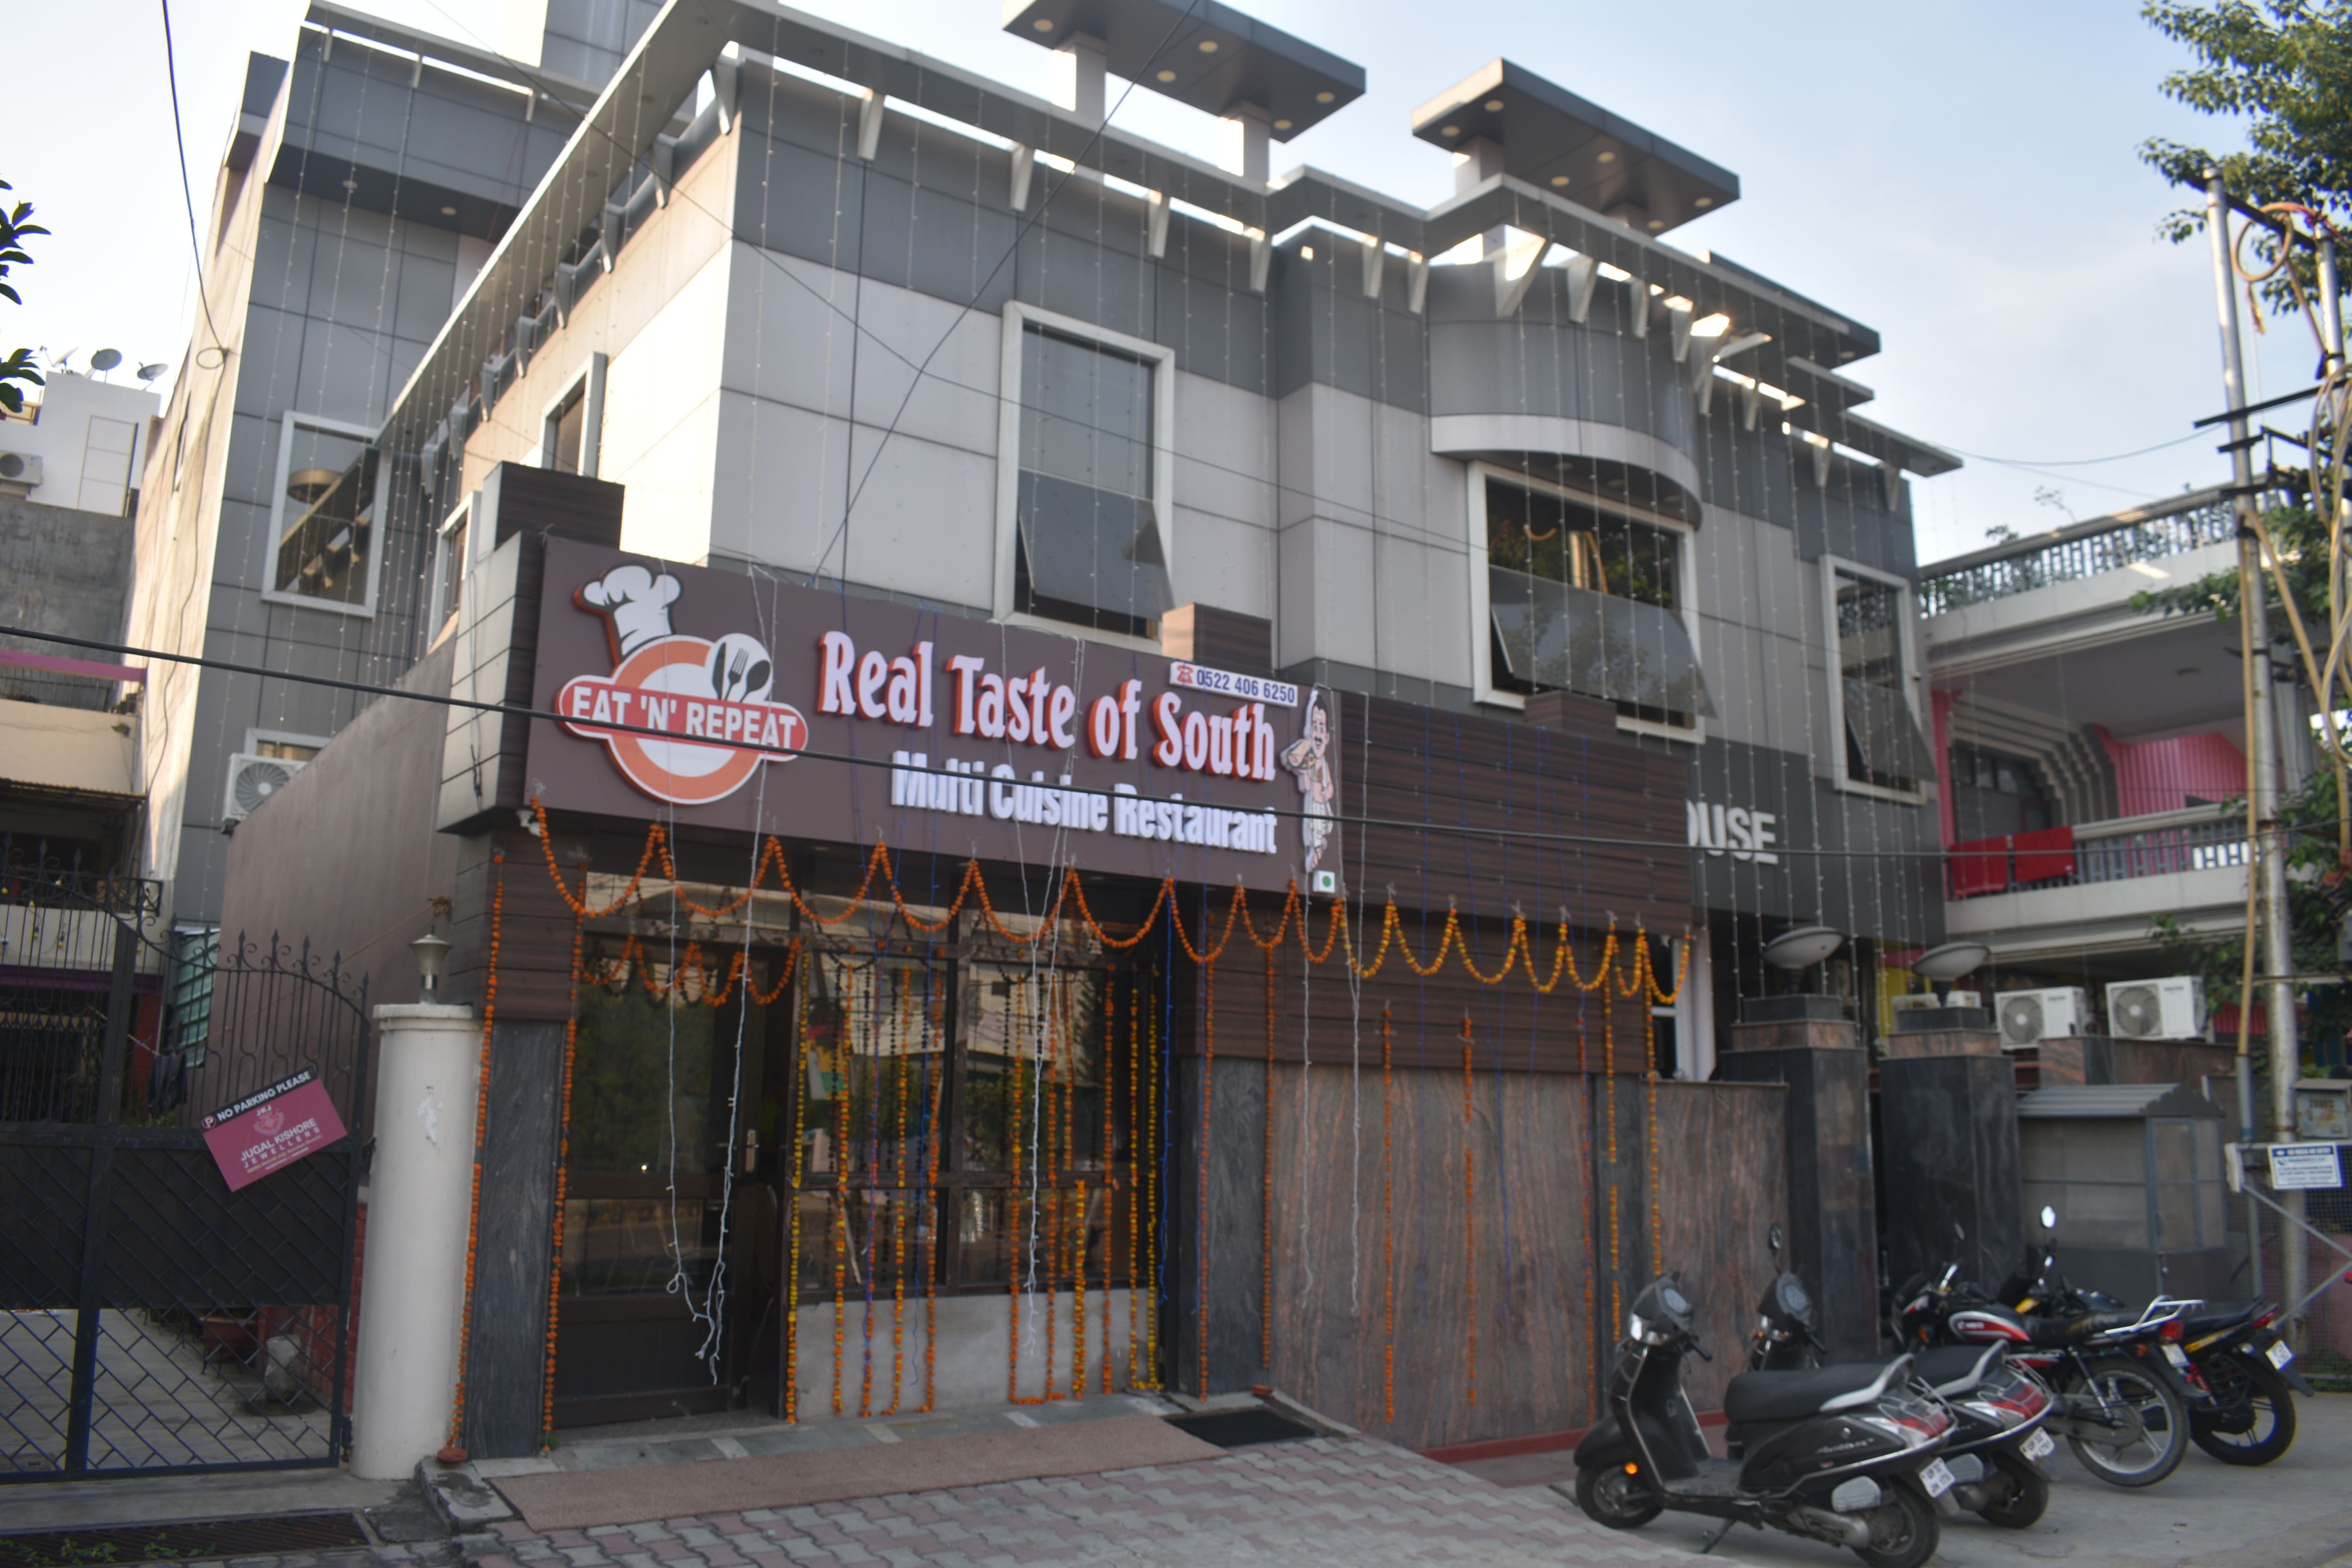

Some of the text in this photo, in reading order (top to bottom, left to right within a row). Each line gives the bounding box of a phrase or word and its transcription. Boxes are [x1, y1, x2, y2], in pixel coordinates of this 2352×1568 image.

[819, 631, 1276, 781] Real Taste of South
[1196, 669, 1295, 703] 0522 406 6250
[572, 685, 631, 725] EAT
[686, 701, 797, 752] REPEAT
[891, 750, 1277, 854] Multi Cuisine Restaurant
[217, 1108, 233, 1122] NO
[234, 1088, 276, 1114] PARKING
[276, 1071, 311, 1093] PLEASE
[255, 1105, 272, 1116] JKJ
[241, 1140, 275, 1162] JUGAL
[274, 1117, 317, 1144] KISHORE
